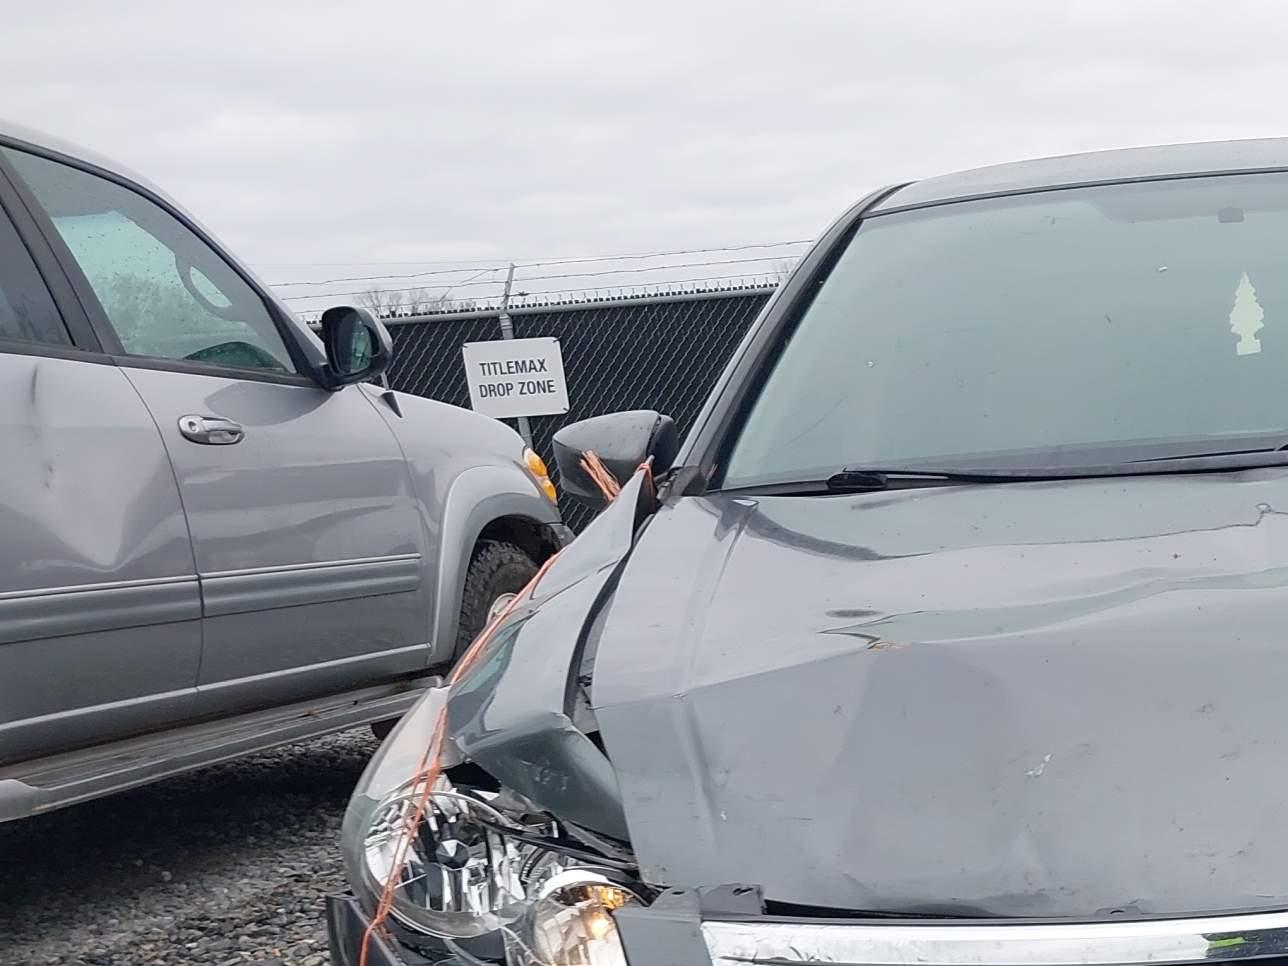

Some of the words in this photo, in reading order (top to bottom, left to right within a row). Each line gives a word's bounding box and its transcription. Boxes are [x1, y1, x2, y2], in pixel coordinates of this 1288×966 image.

[479, 359, 548, 376] TITLEMAX
[479, 382, 514, 398] DROP
[518, 379, 556, 396] ZONE
